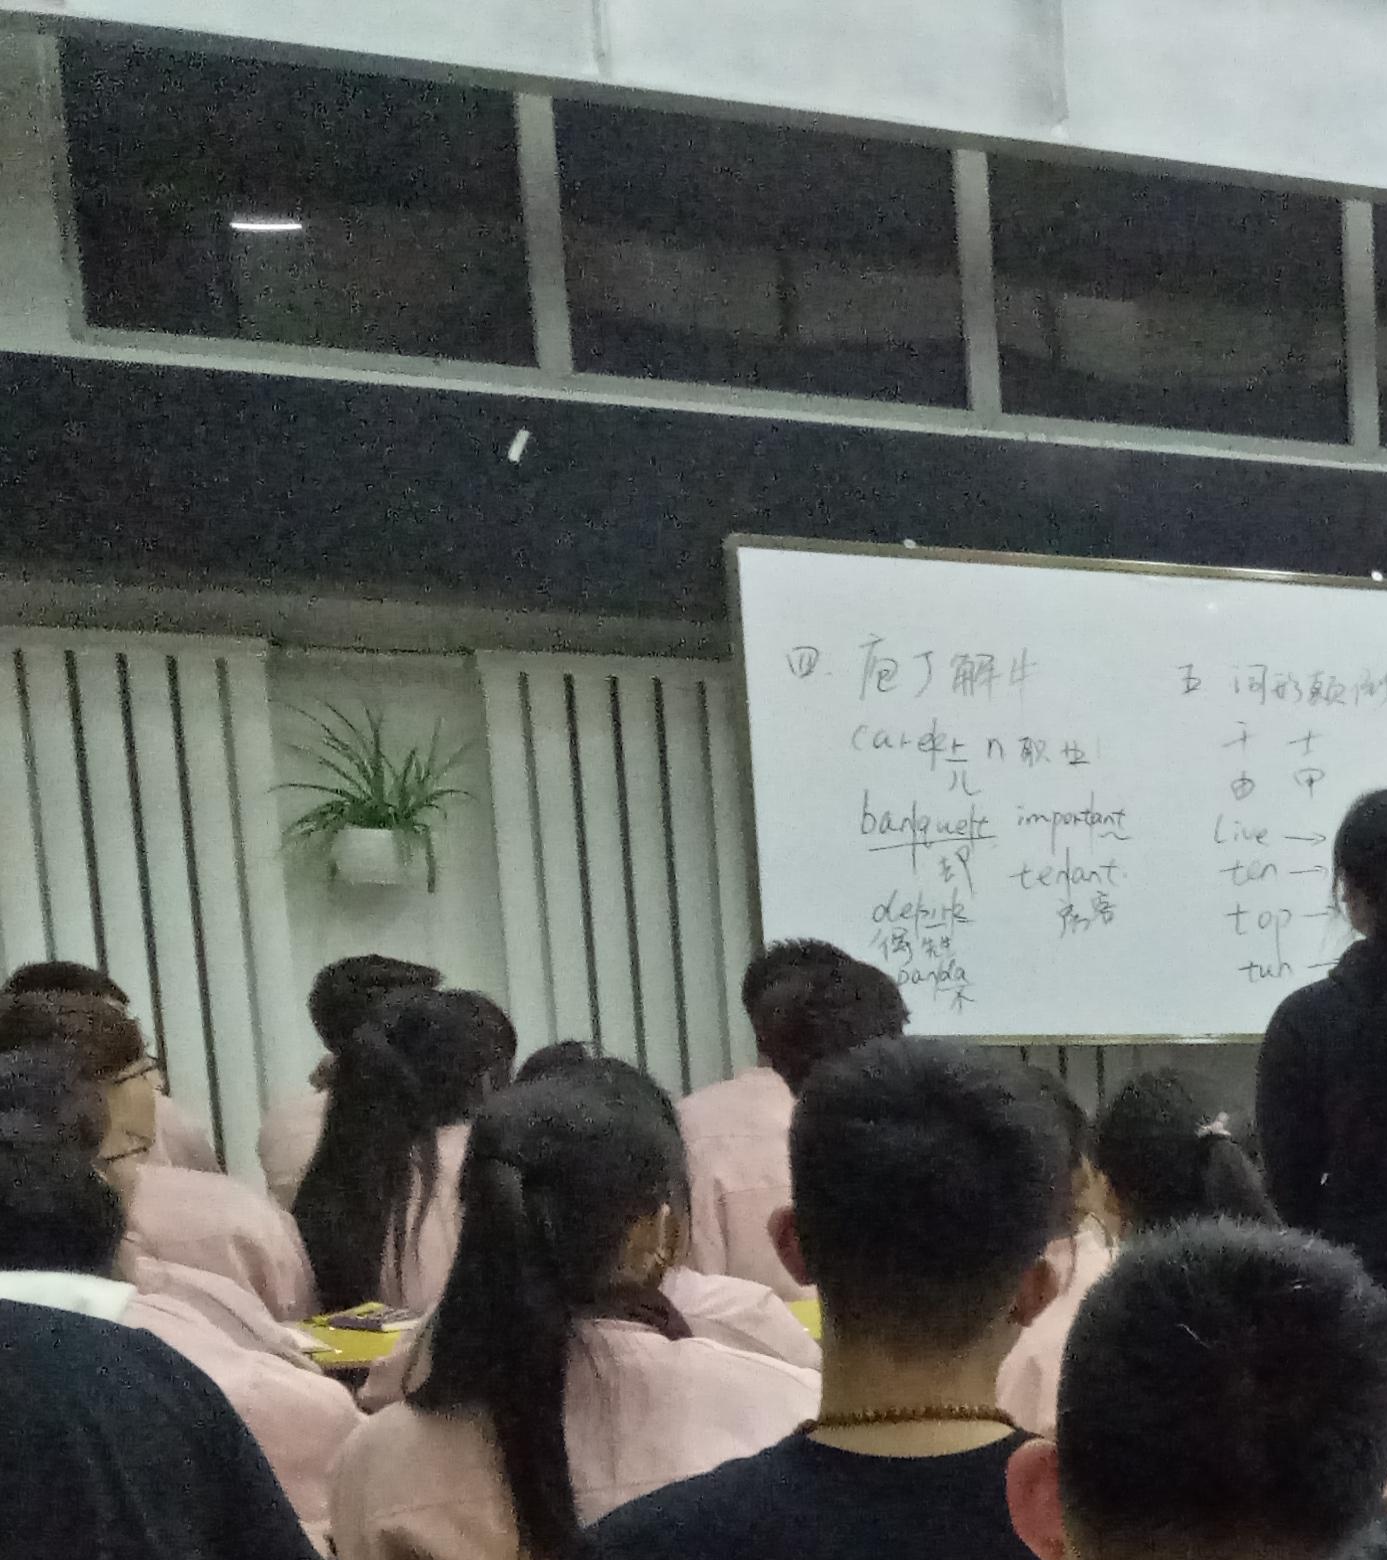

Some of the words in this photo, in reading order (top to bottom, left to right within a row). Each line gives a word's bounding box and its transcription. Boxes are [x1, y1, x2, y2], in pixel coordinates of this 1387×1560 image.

[1016, 800, 1128, 856] important
[1218, 858, 1279, 887] ten
[1223, 901, 1293, 966] top
